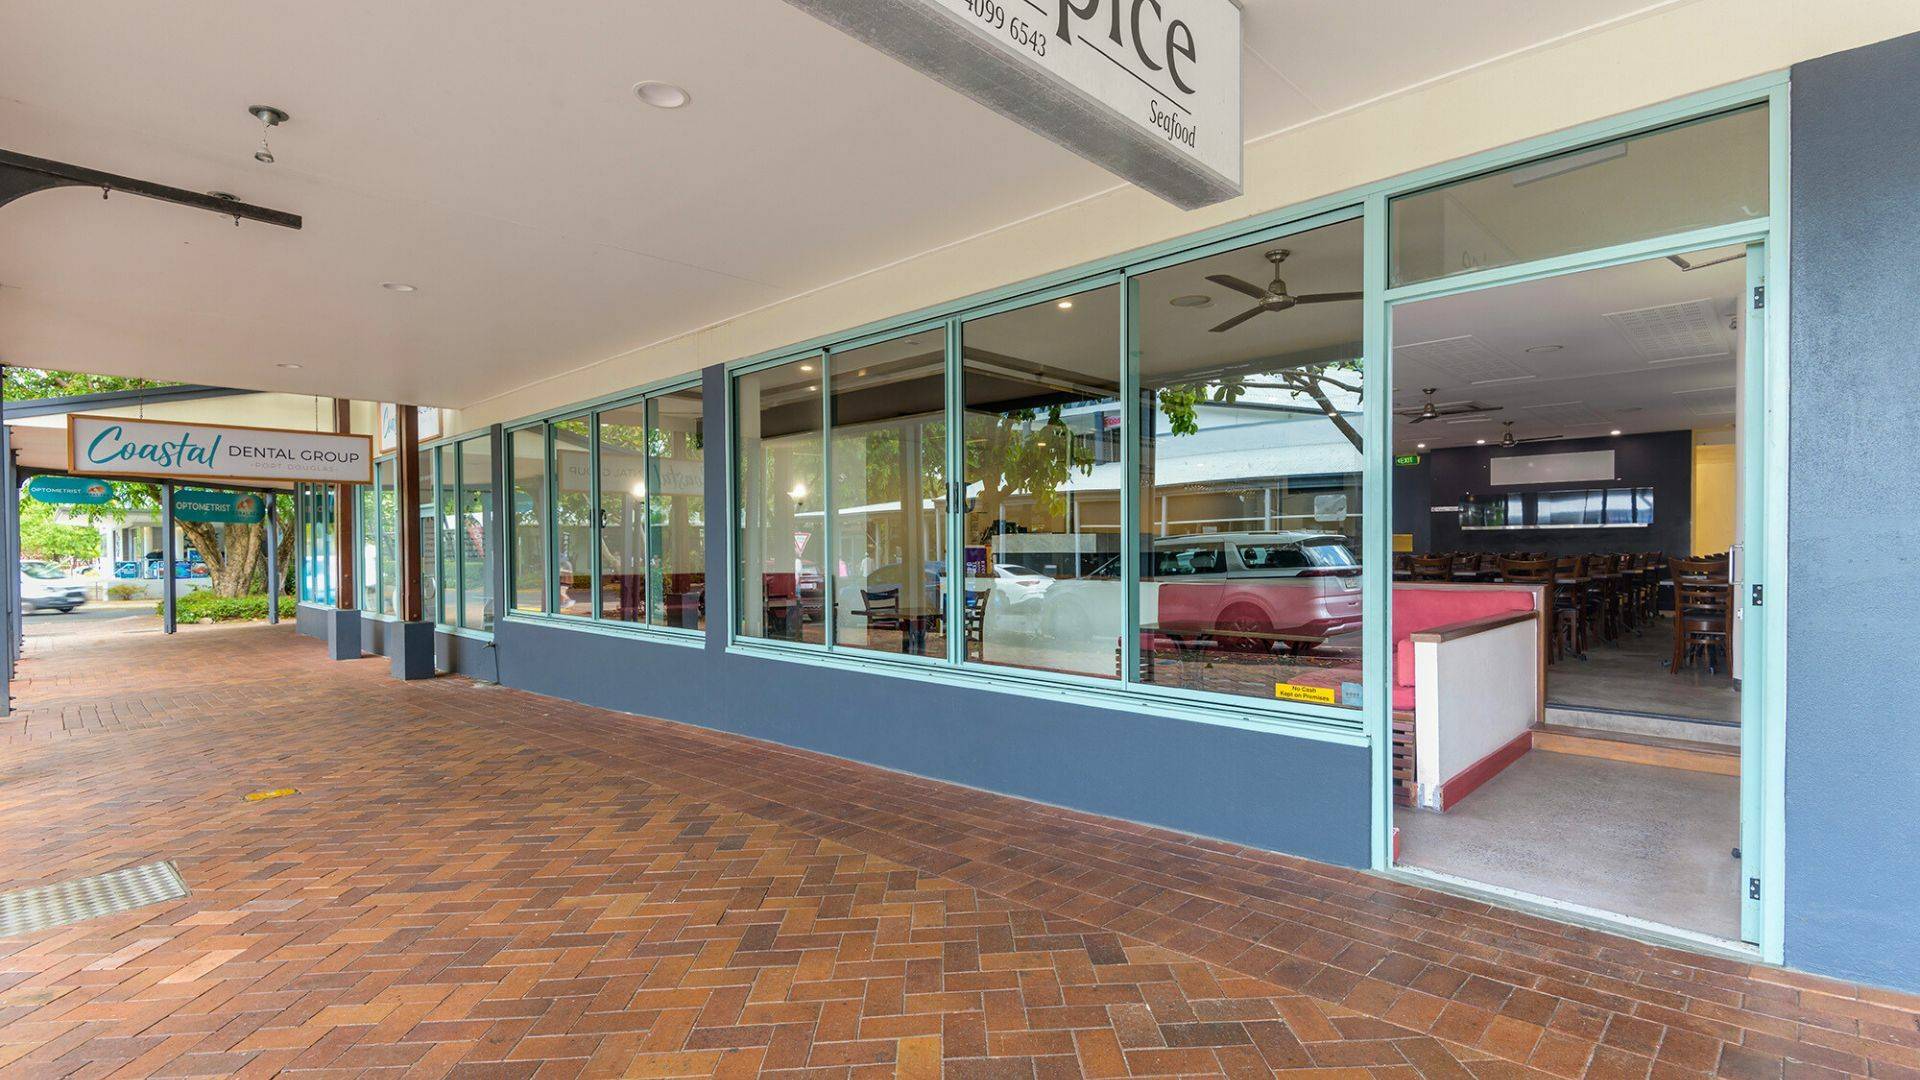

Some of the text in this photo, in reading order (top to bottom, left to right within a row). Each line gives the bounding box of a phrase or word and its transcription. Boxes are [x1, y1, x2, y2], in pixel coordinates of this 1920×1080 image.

[1010, 17, 1046, 57] 6543
[1150, 100, 1196, 148] Seafood
[88, 425, 359, 469] Coastal DENTAL GROUP
[175, 501, 231, 511] OPTOMETRIST
[1303, 693, 1330, 702] Premises
